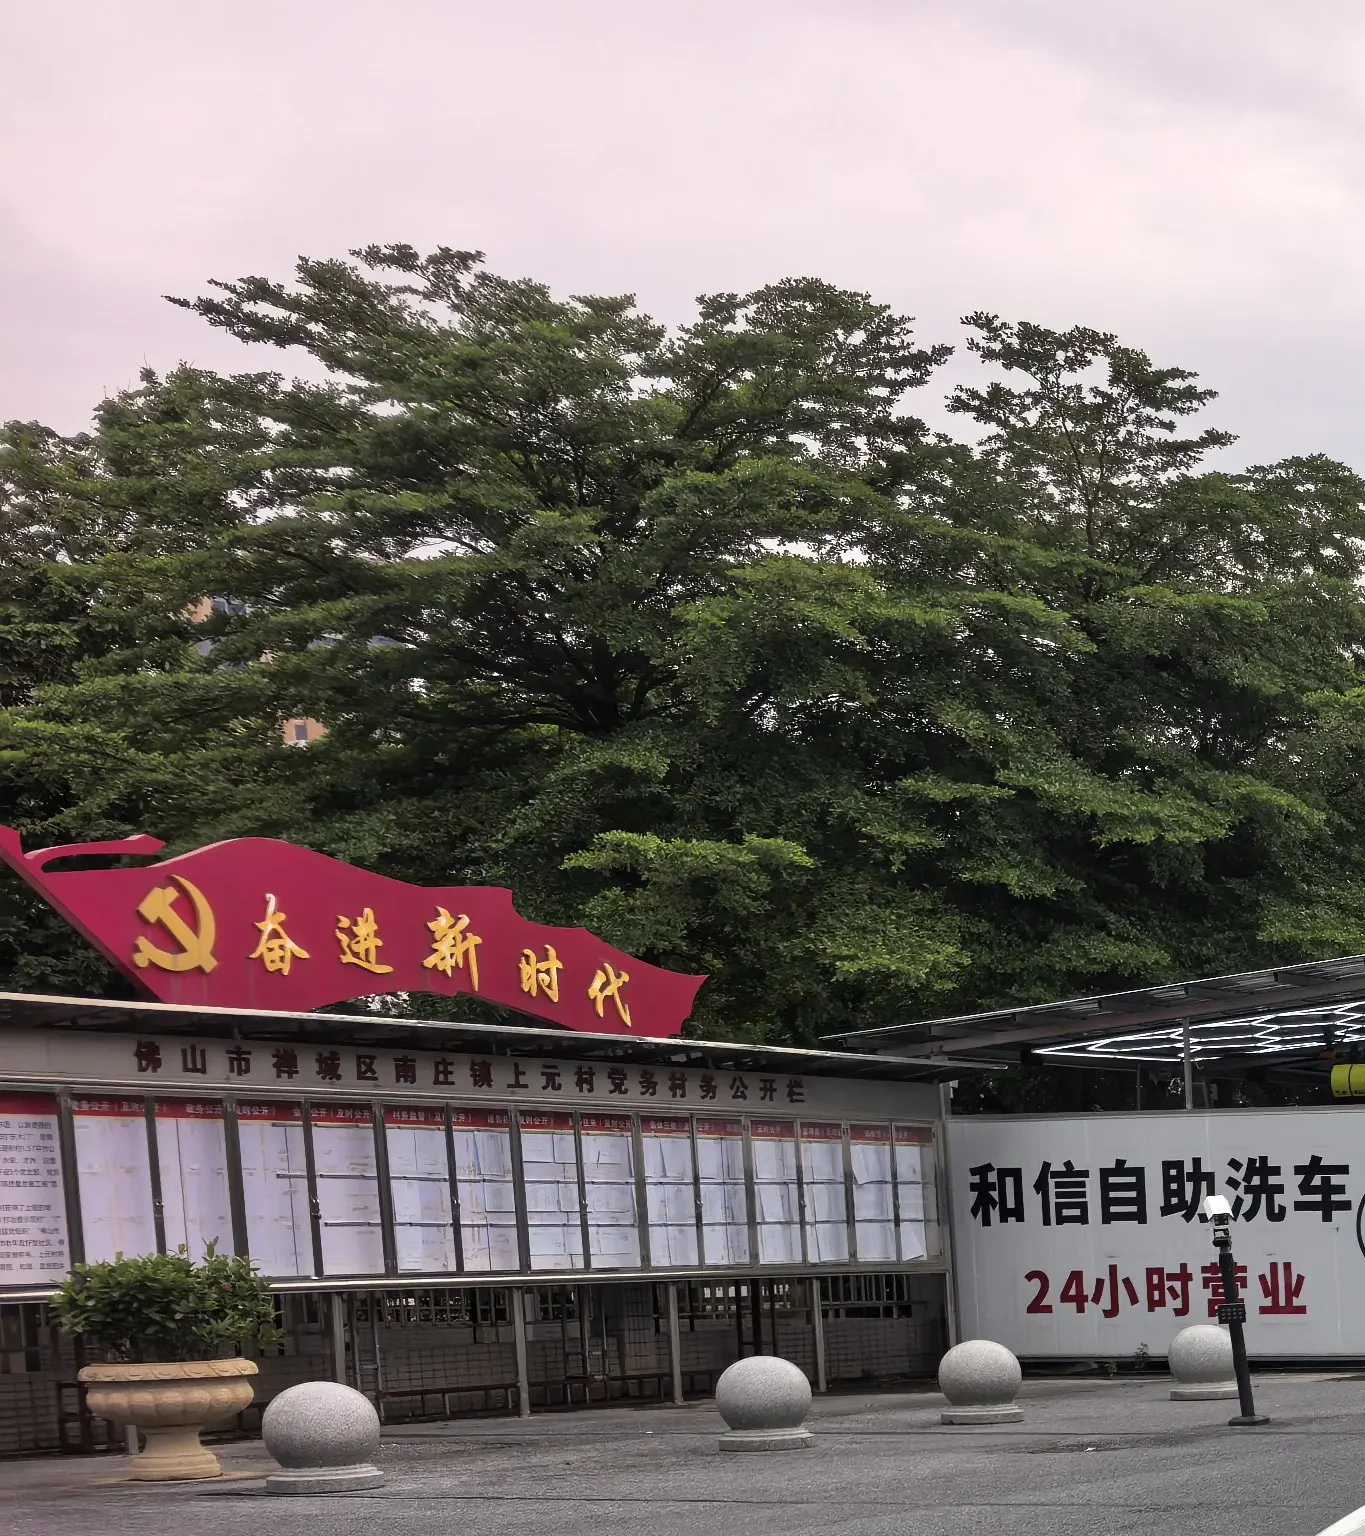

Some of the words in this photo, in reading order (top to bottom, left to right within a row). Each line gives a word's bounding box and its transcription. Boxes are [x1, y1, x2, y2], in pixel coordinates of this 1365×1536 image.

[248, 892, 632, 1028] 奋进新时代
[969, 1155, 1352, 1227] 和信自助洗车
[1024, 1262, 1307, 1318] 24小时营业
